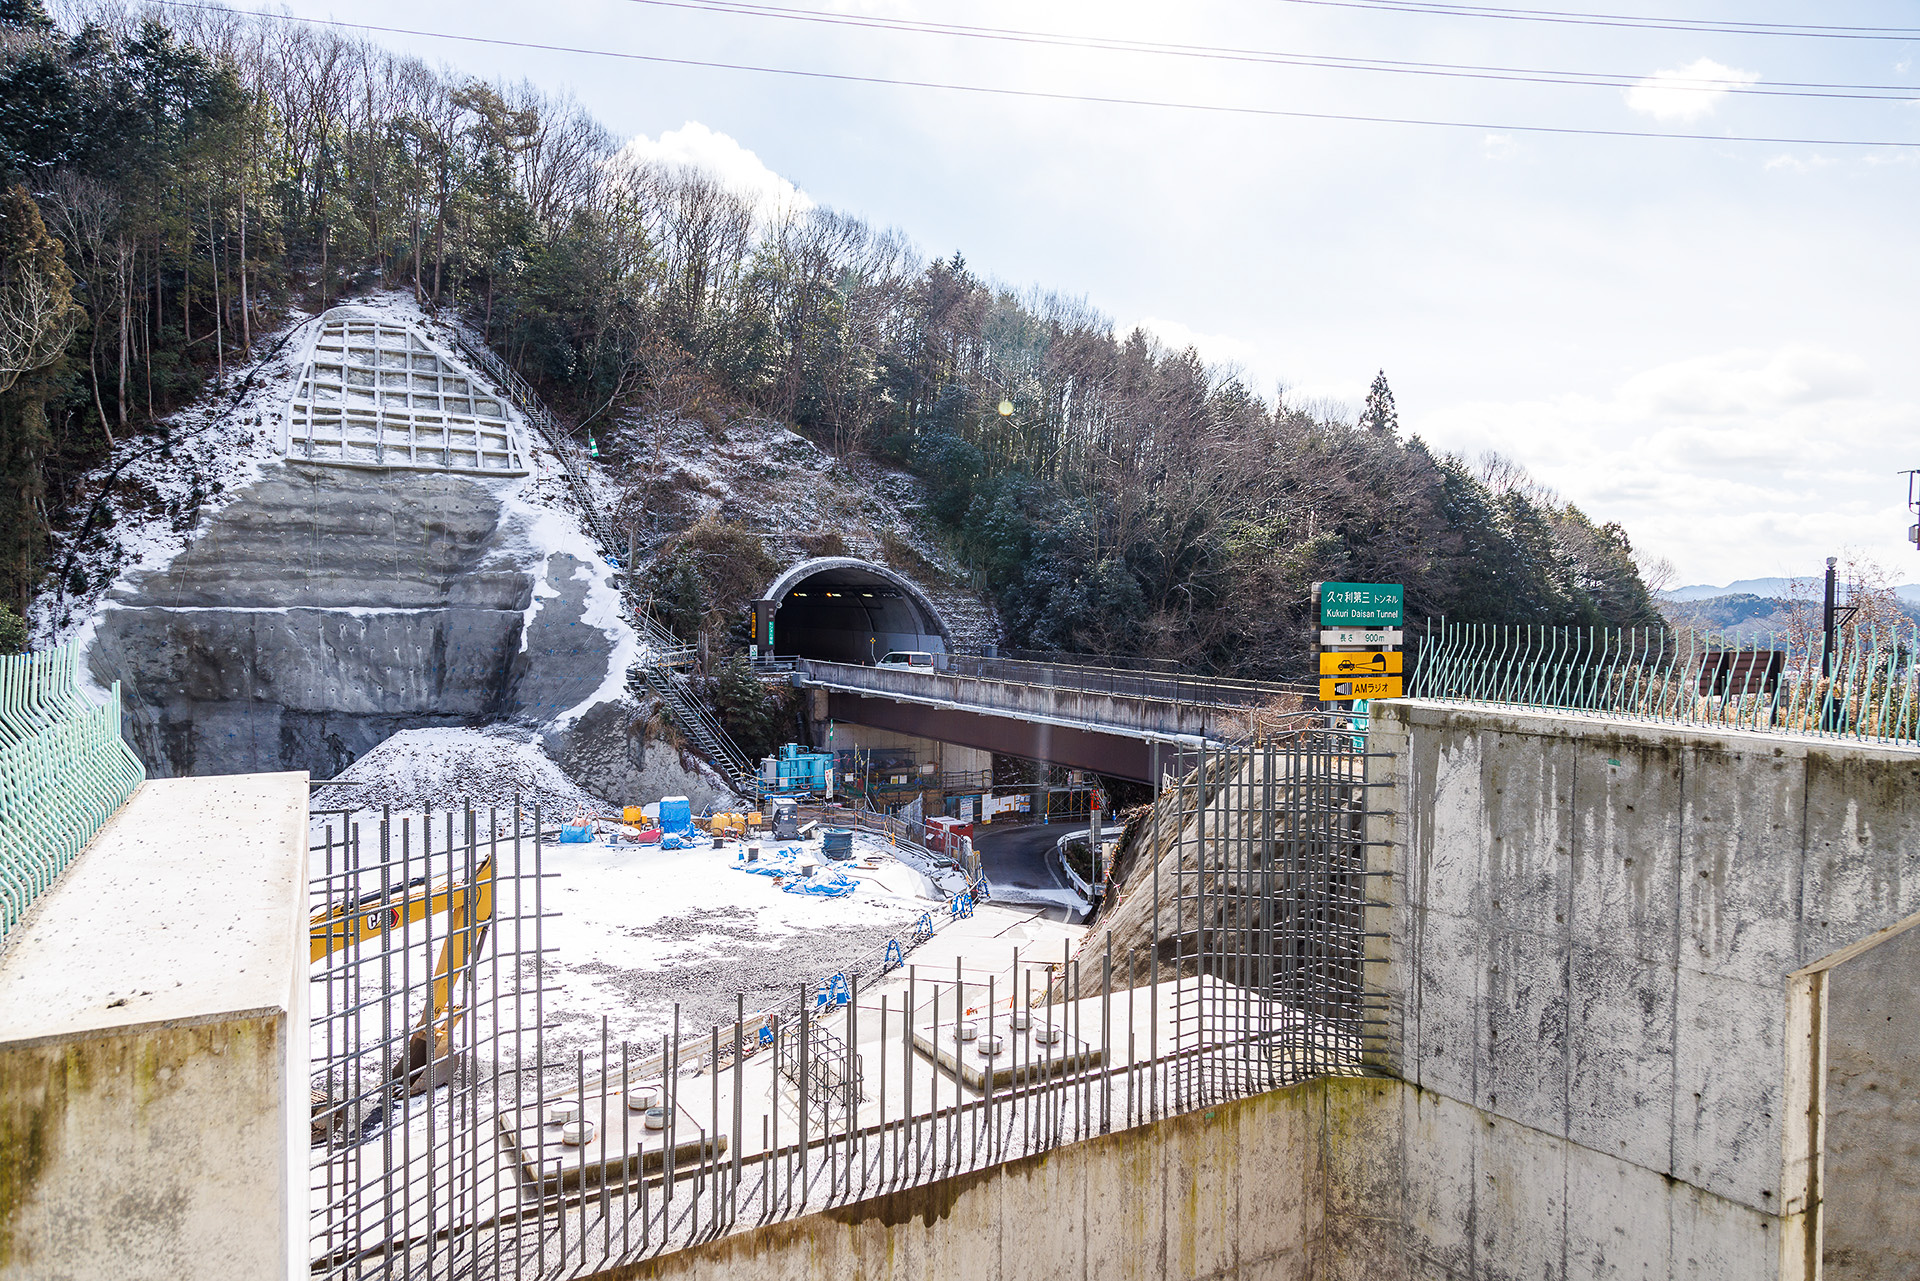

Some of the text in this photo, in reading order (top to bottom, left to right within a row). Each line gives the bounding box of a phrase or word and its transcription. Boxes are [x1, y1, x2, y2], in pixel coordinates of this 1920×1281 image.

[1327, 591, 1399, 604] 久々利第三 トンネル
[1327, 609, 1398, 618] Kukuri Daisan Tunnel
[1340, 634, 1385, 642] 長さ 900m
[1354, 683, 1389, 694] AMラジオ
